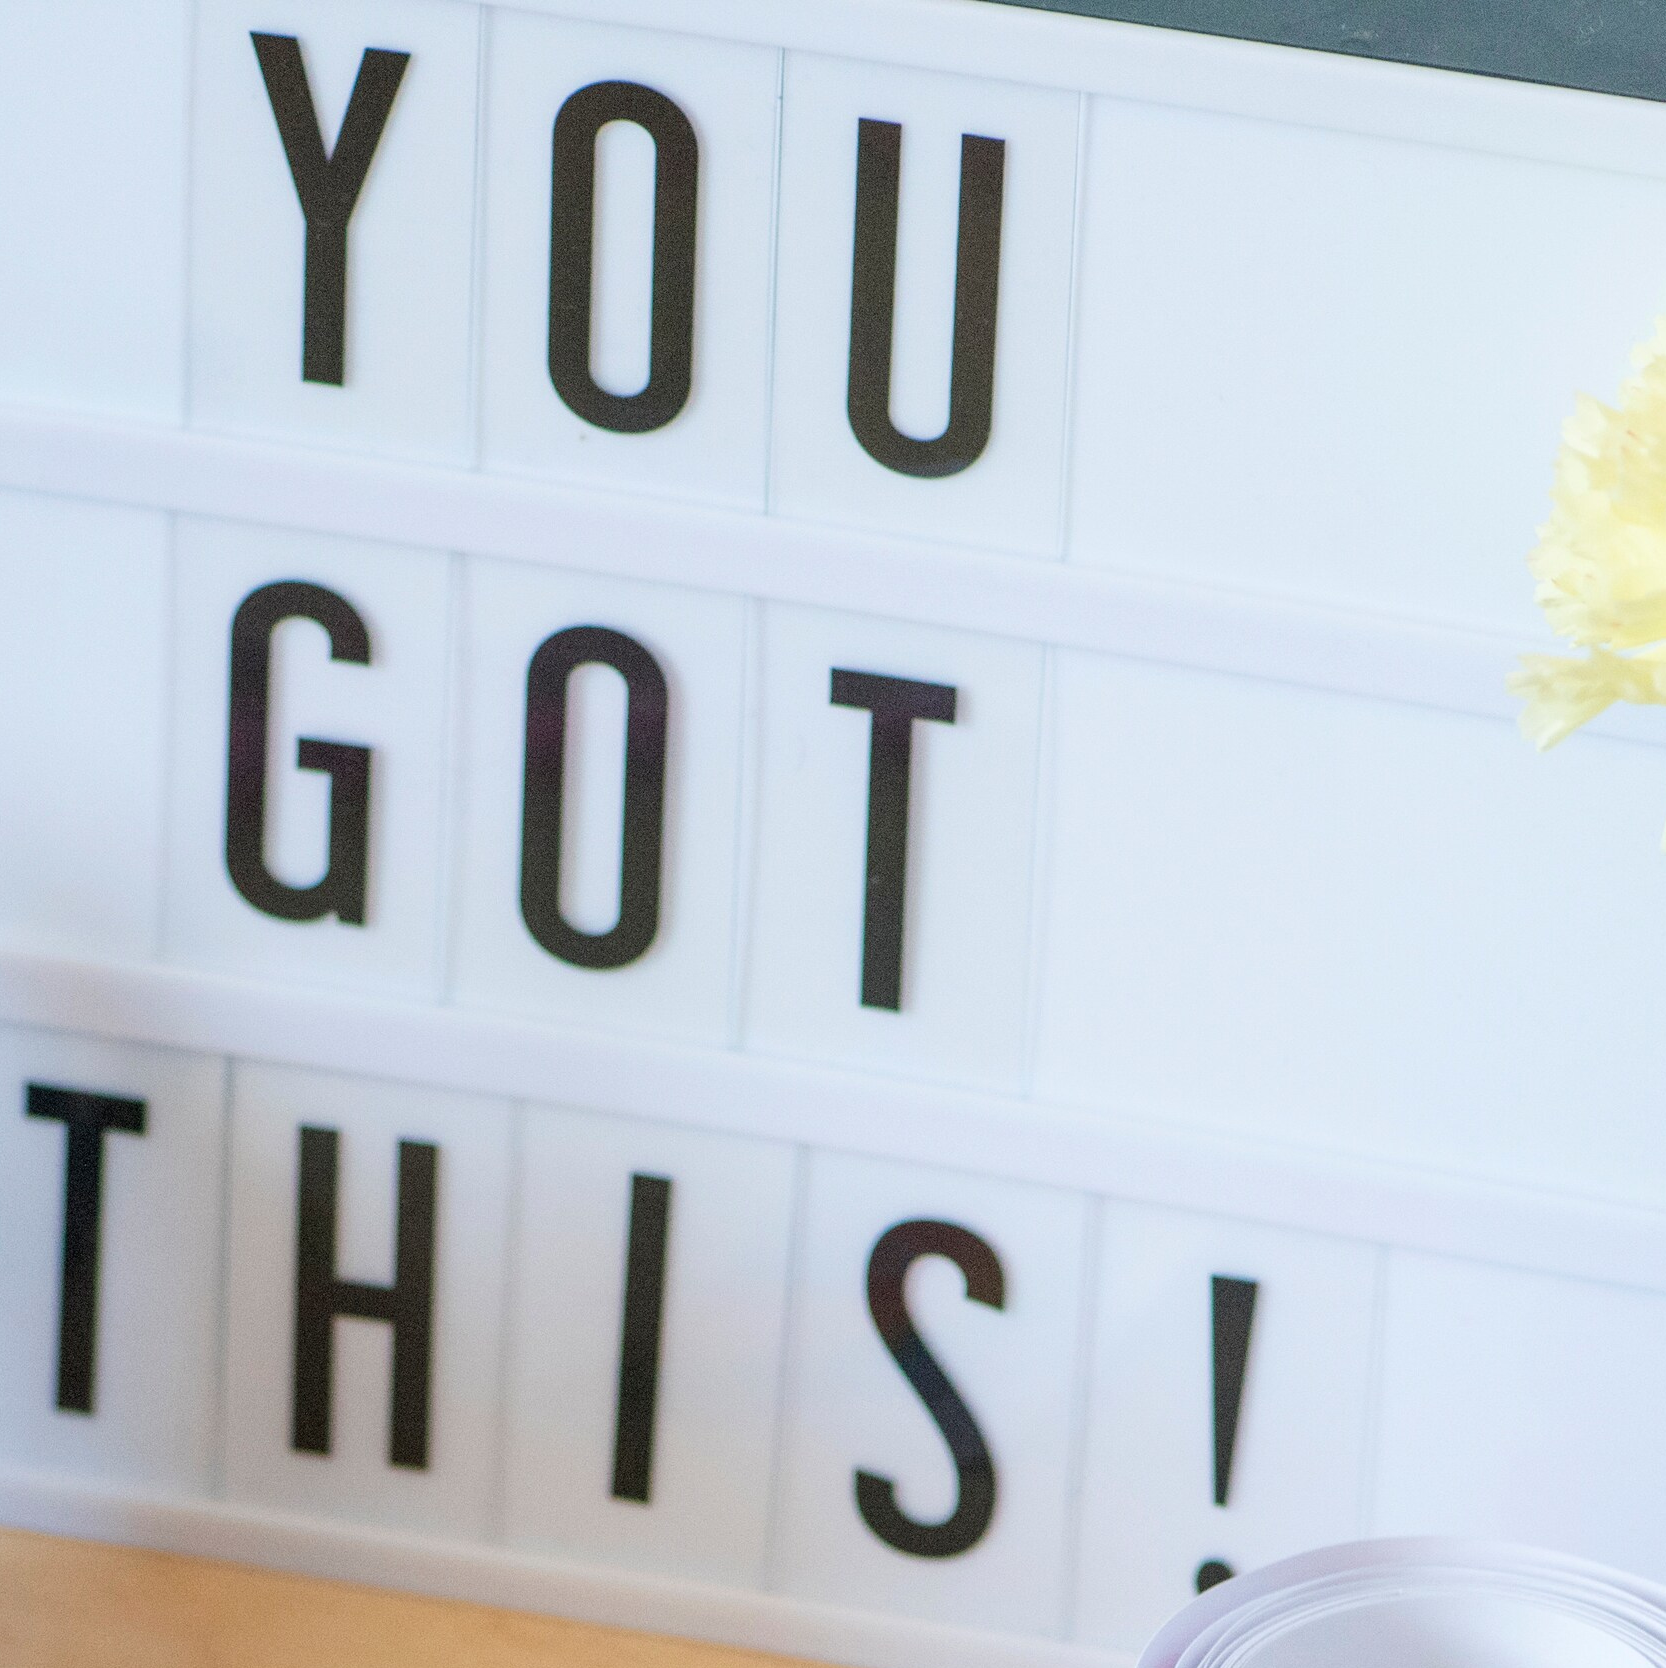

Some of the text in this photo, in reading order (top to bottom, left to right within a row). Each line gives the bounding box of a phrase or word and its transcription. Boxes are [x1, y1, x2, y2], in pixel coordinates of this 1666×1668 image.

[249, 31, 1007, 480] YOU
[223, 580, 959, 1012] GOT
[23, 1081, 1259, 1594] THIS!
